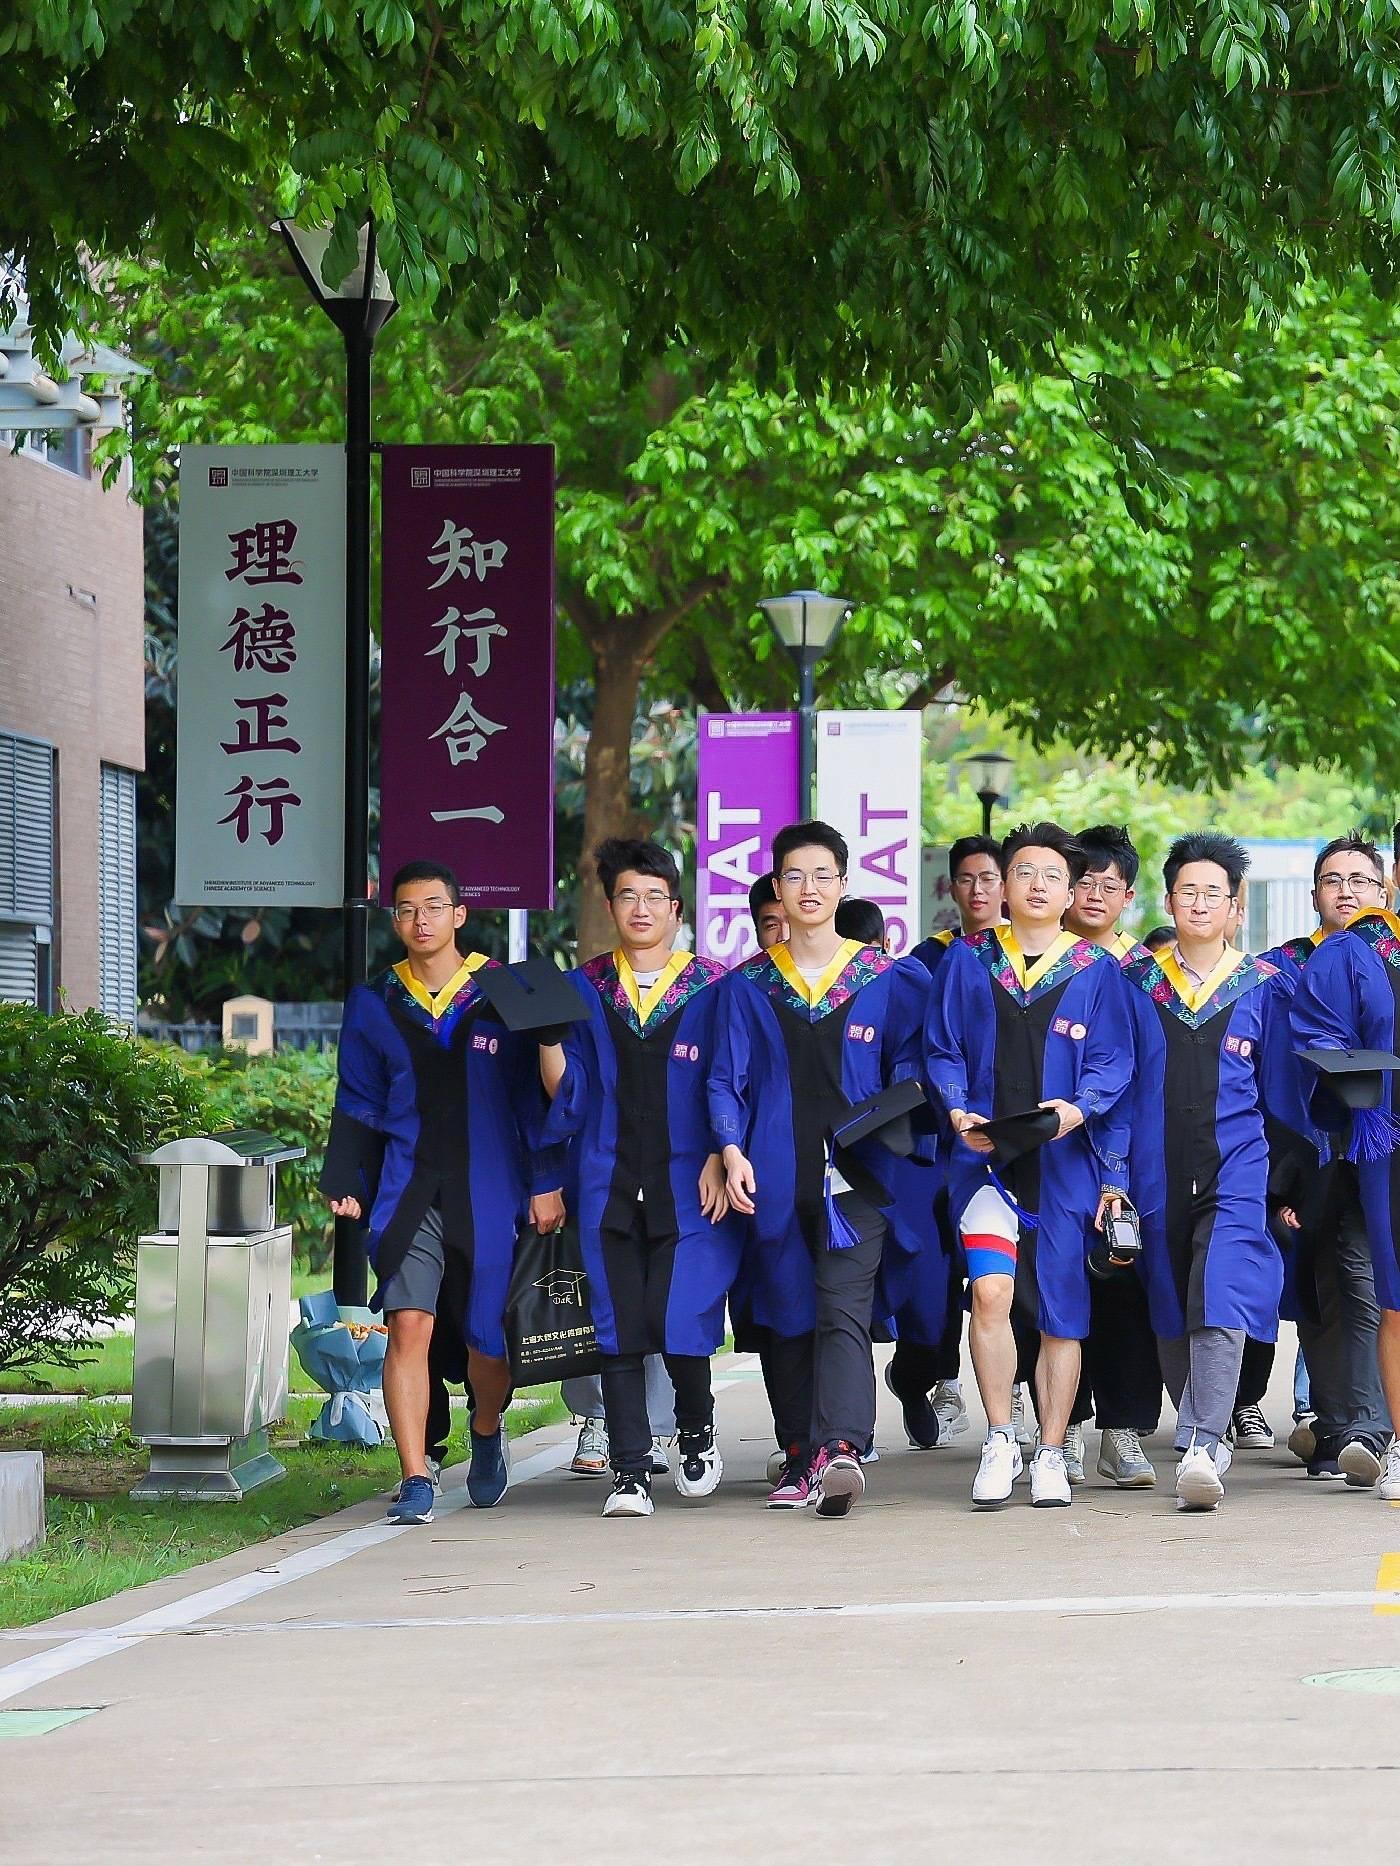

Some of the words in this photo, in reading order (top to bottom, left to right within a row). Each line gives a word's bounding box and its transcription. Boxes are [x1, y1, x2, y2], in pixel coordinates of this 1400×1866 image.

[216, 519, 303, 846] 理德正行
[424, 519, 508, 825] 知行合一
[706, 791, 761, 956] SIAT
